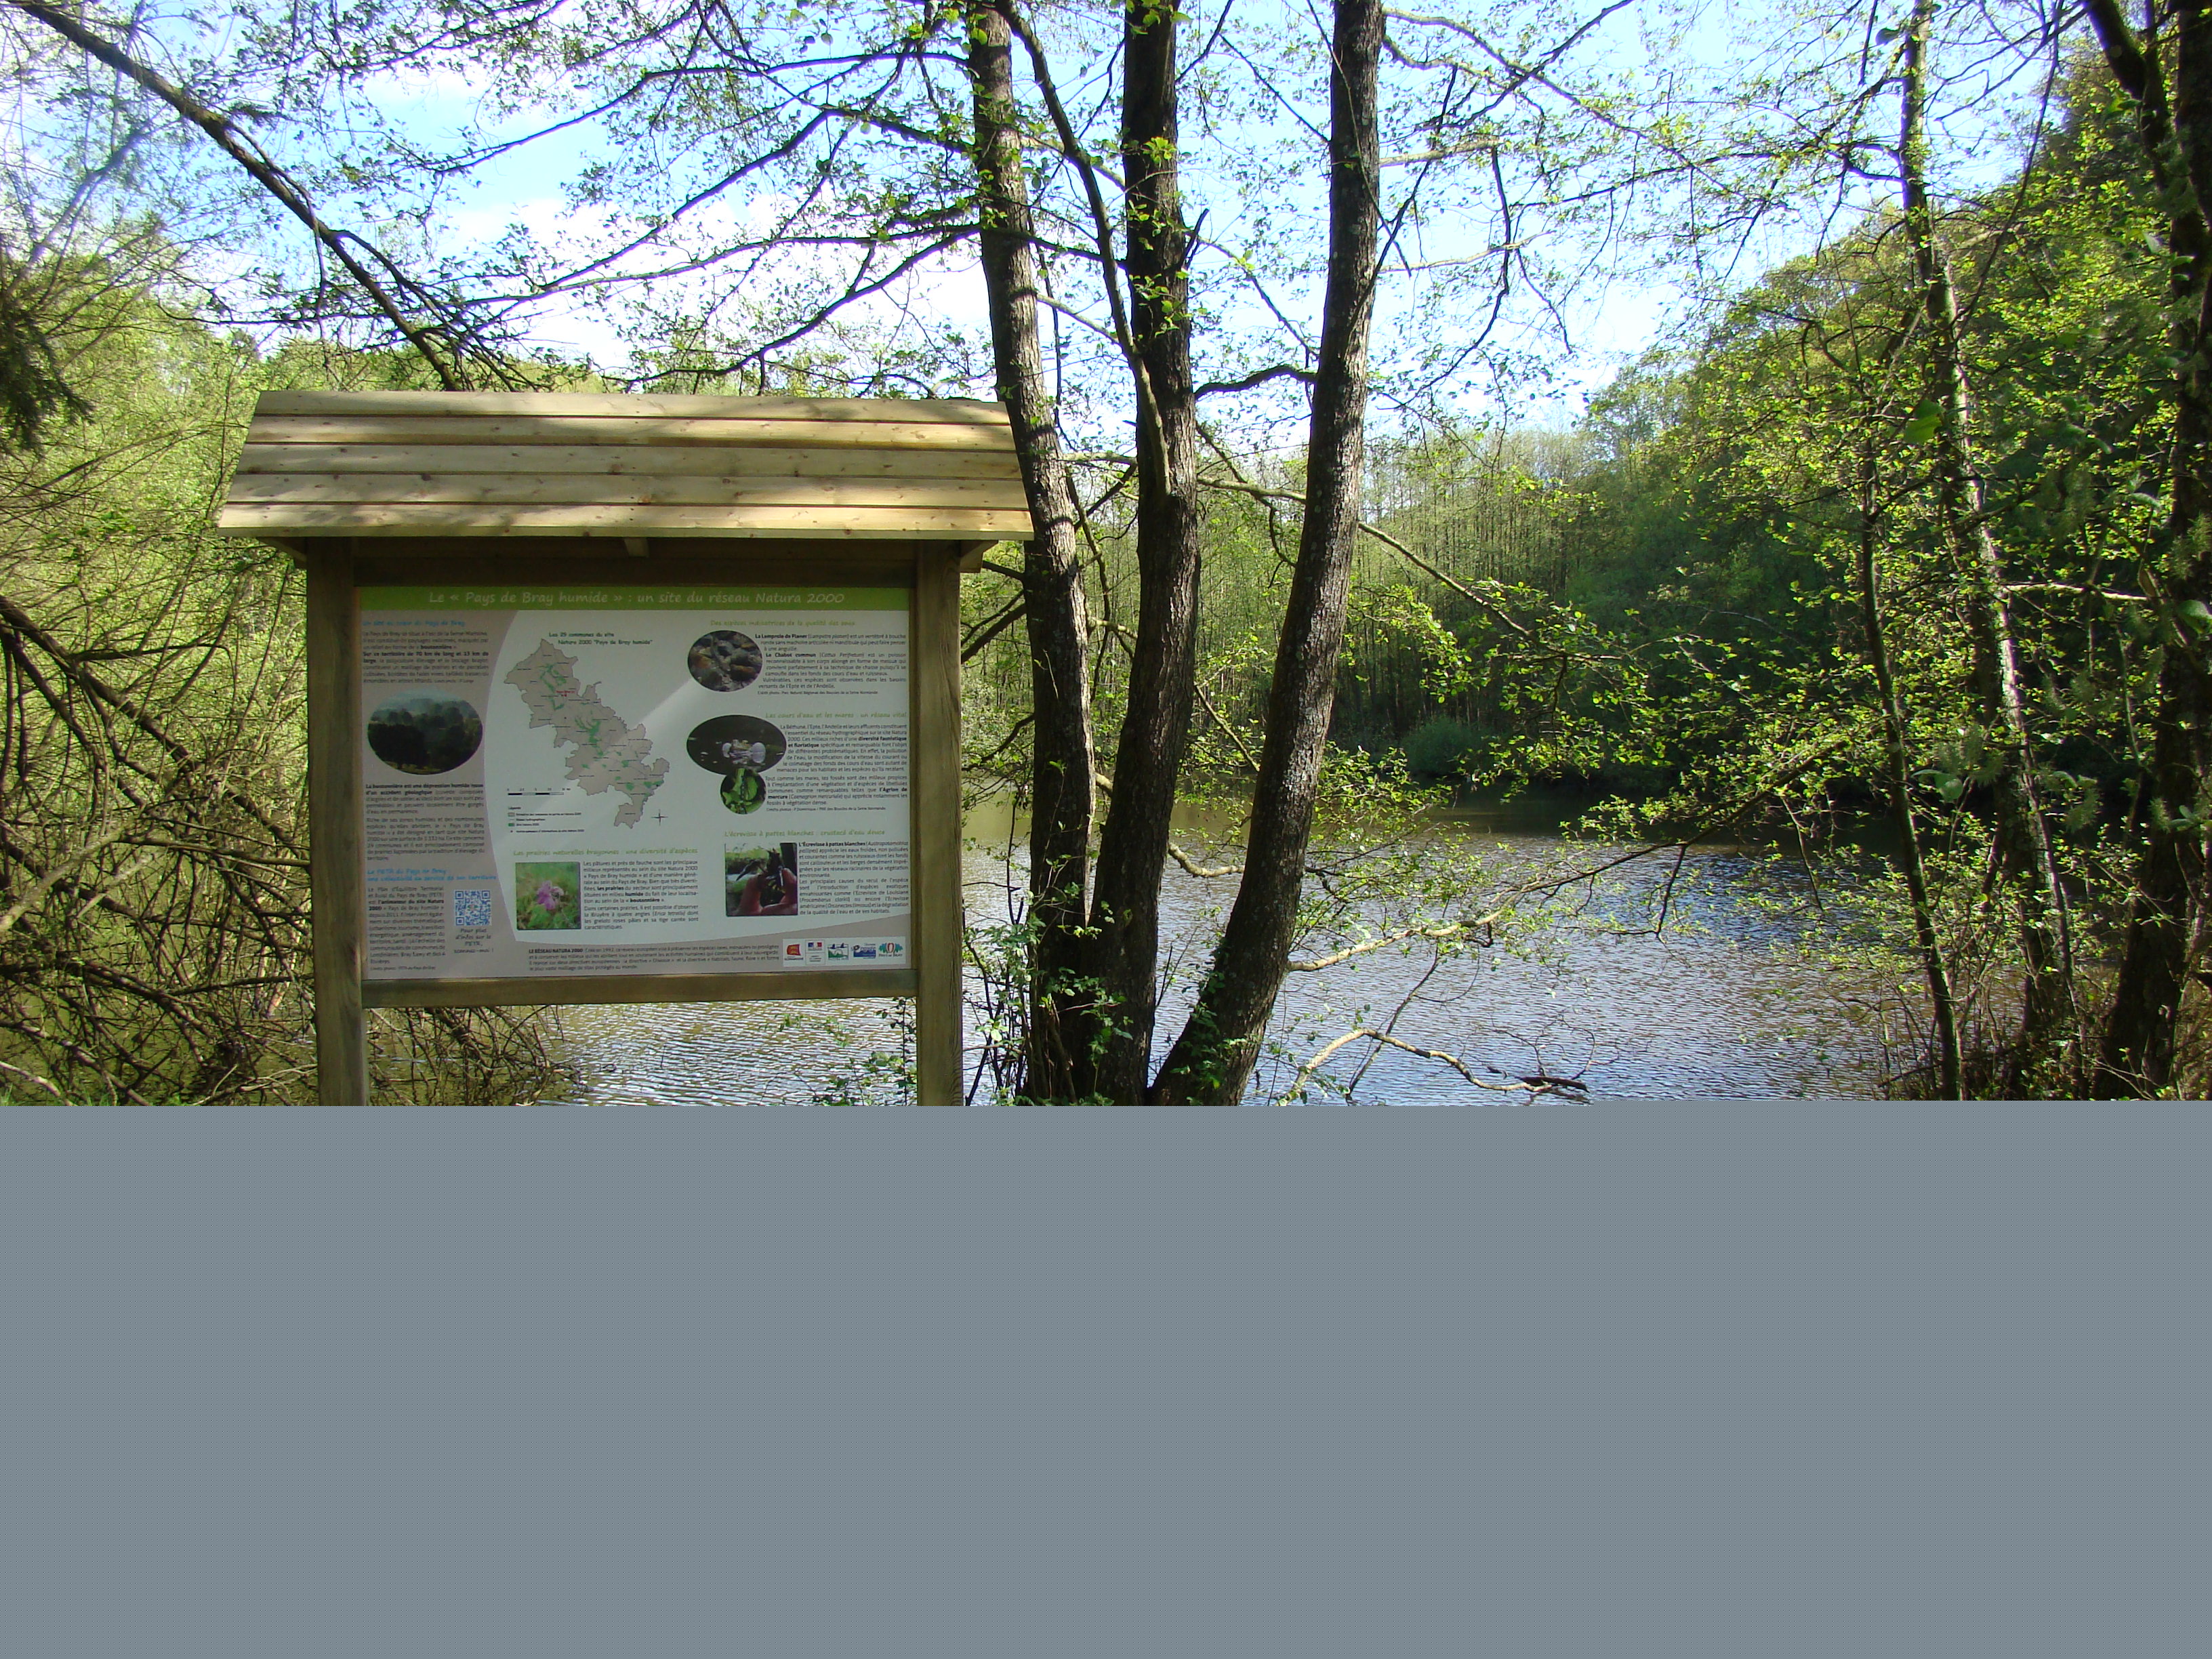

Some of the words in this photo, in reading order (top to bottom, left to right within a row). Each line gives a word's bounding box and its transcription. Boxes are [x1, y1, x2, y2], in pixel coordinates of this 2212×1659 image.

[430, 592, 444, 602] Le
[466, 592, 495, 606] Pays
[501, 592, 516, 602] de
[522, 592, 553, 606] Bray
[560, 591, 607, 602] humide
[638, 594, 654, 602] un
[659, 591, 681, 602] site
[687, 591, 703, 602] du
[709, 591, 751, 602] réseau
[756, 592, 801, 602] Natura
[807, 592, 844, 602] 2000
